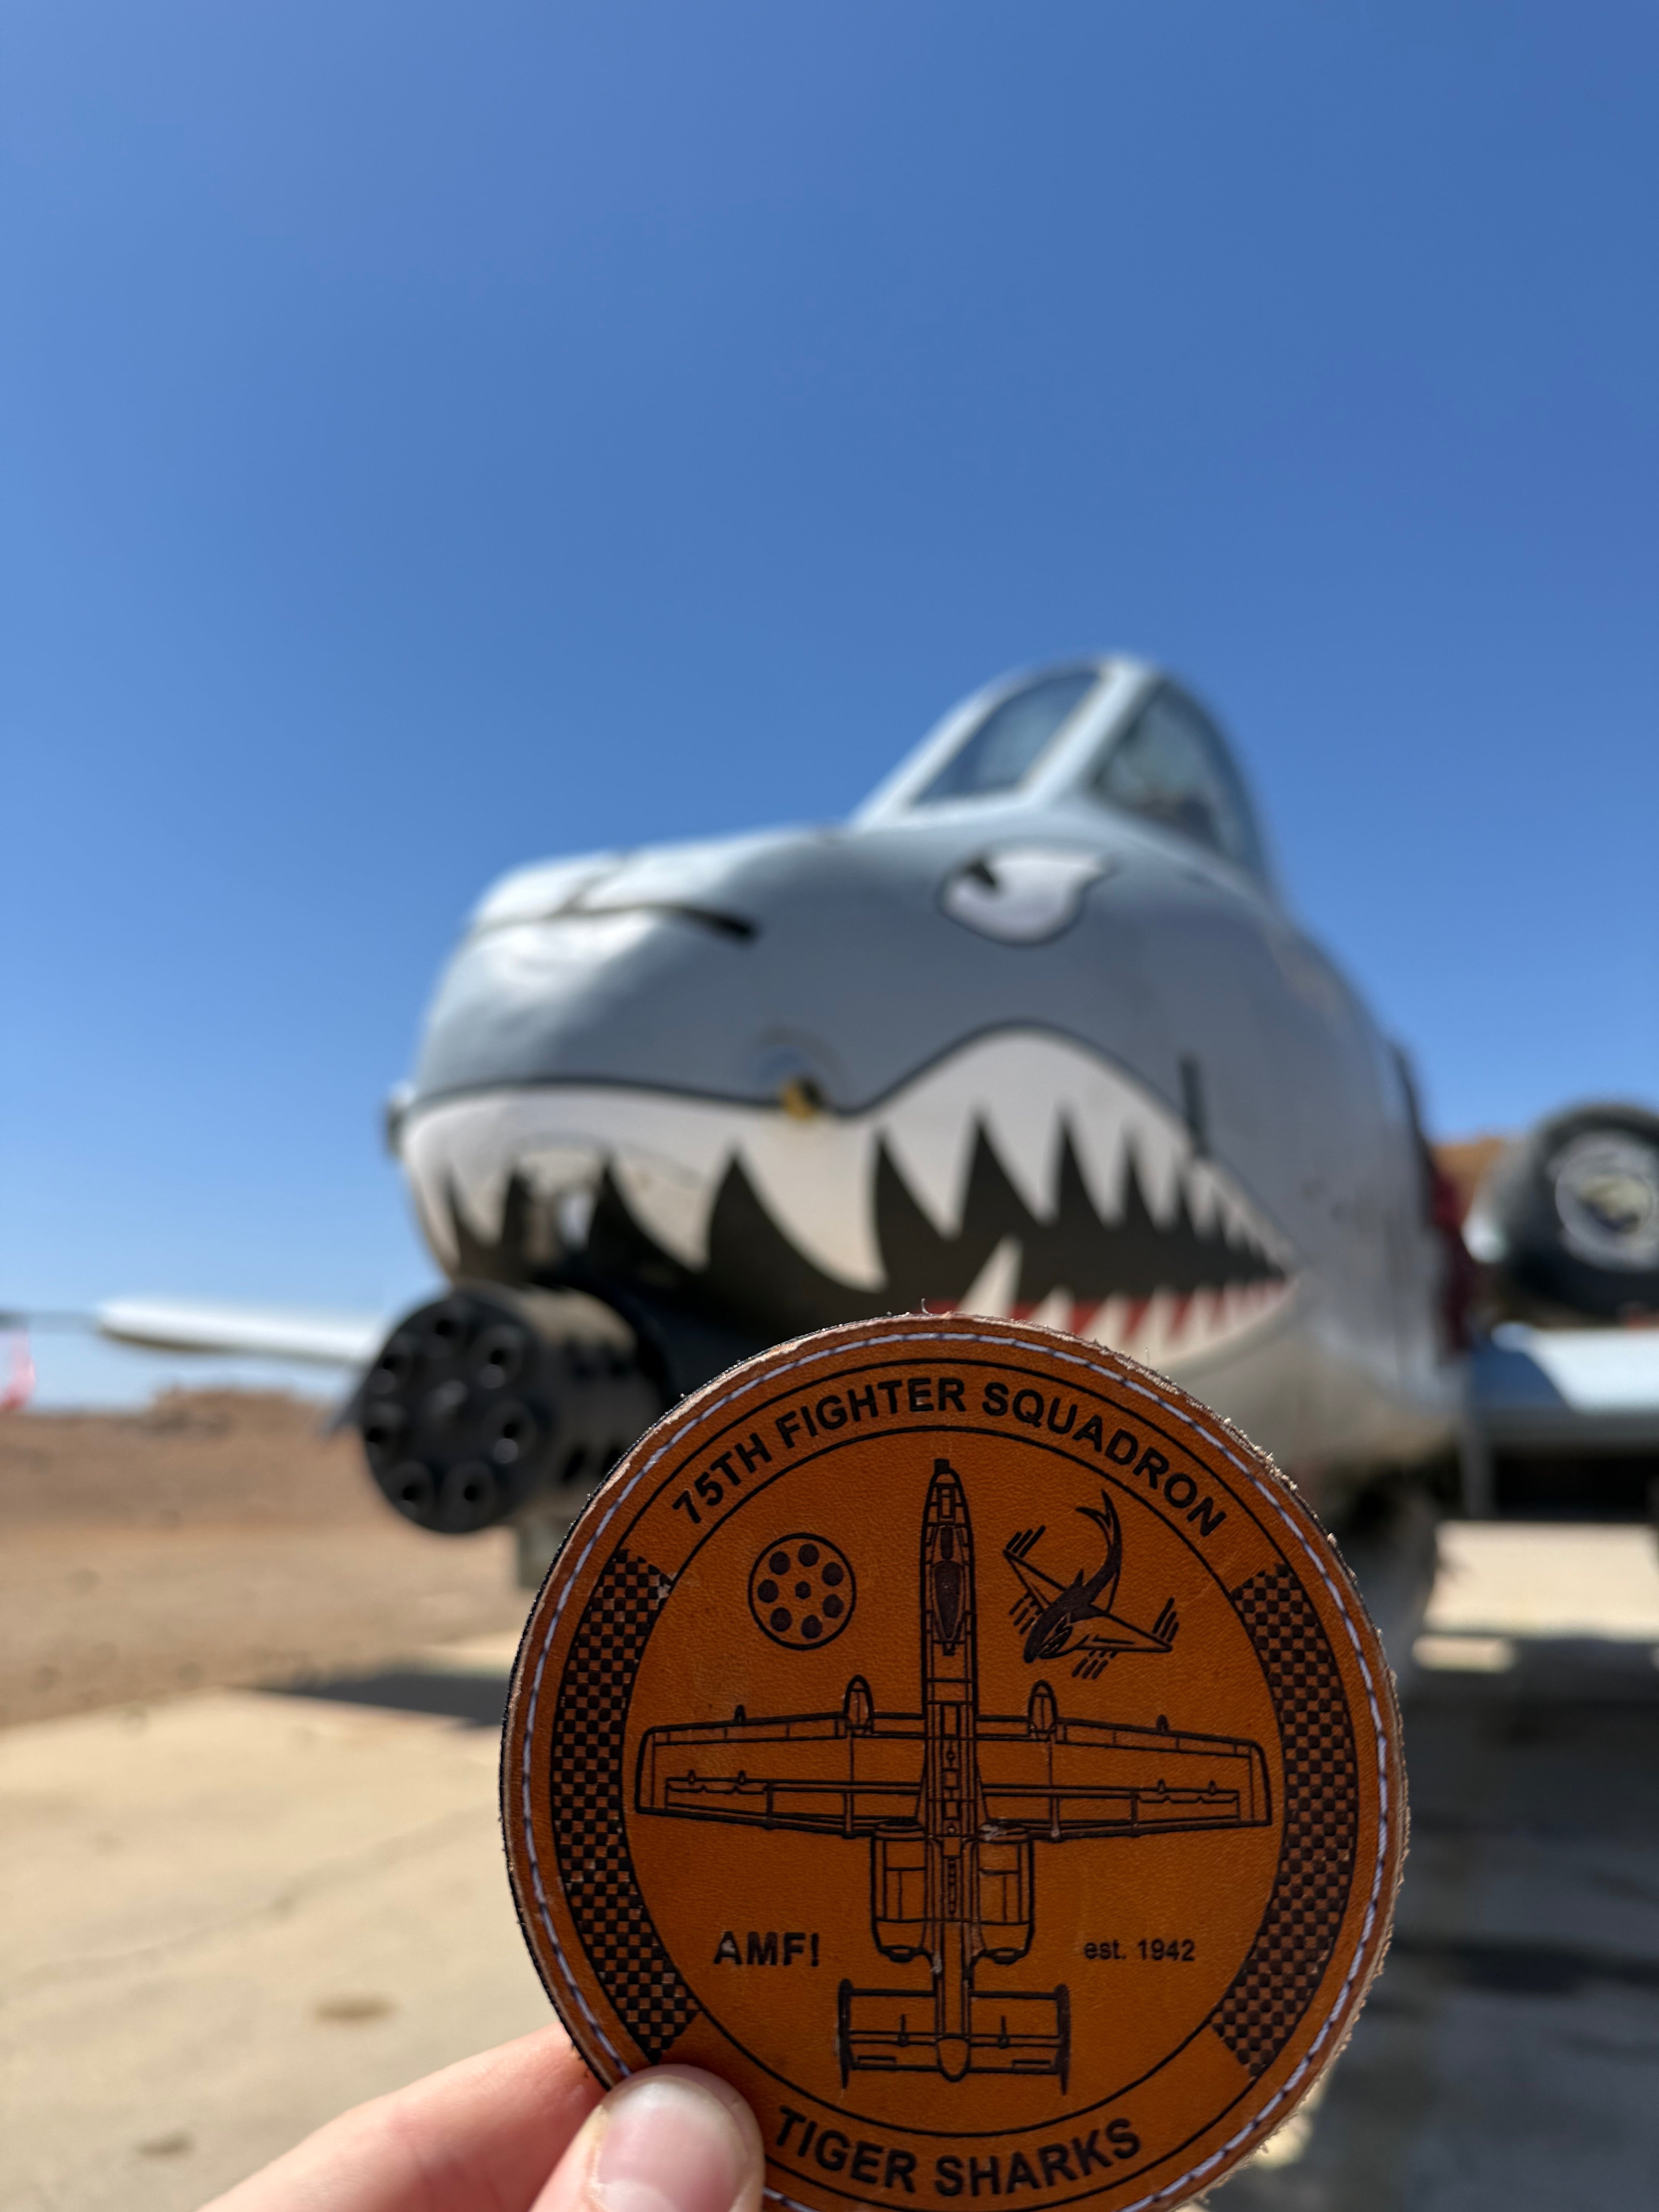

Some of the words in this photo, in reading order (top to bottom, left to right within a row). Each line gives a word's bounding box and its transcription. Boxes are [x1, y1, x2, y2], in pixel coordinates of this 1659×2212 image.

[672, 1433, 772, 1524] 75TH
[775, 1377, 966, 1449] FIGHTER
[982, 1382, 1227, 1537] SQUADRON
[713, 1931, 819, 1967] AMF!
[1084, 1939, 1126, 1960] est.
[1138, 1939, 1195, 1961] 1942
[775, 2105, 918, 2193] TIGER
[934, 2118, 1141, 2196] SHARKS
